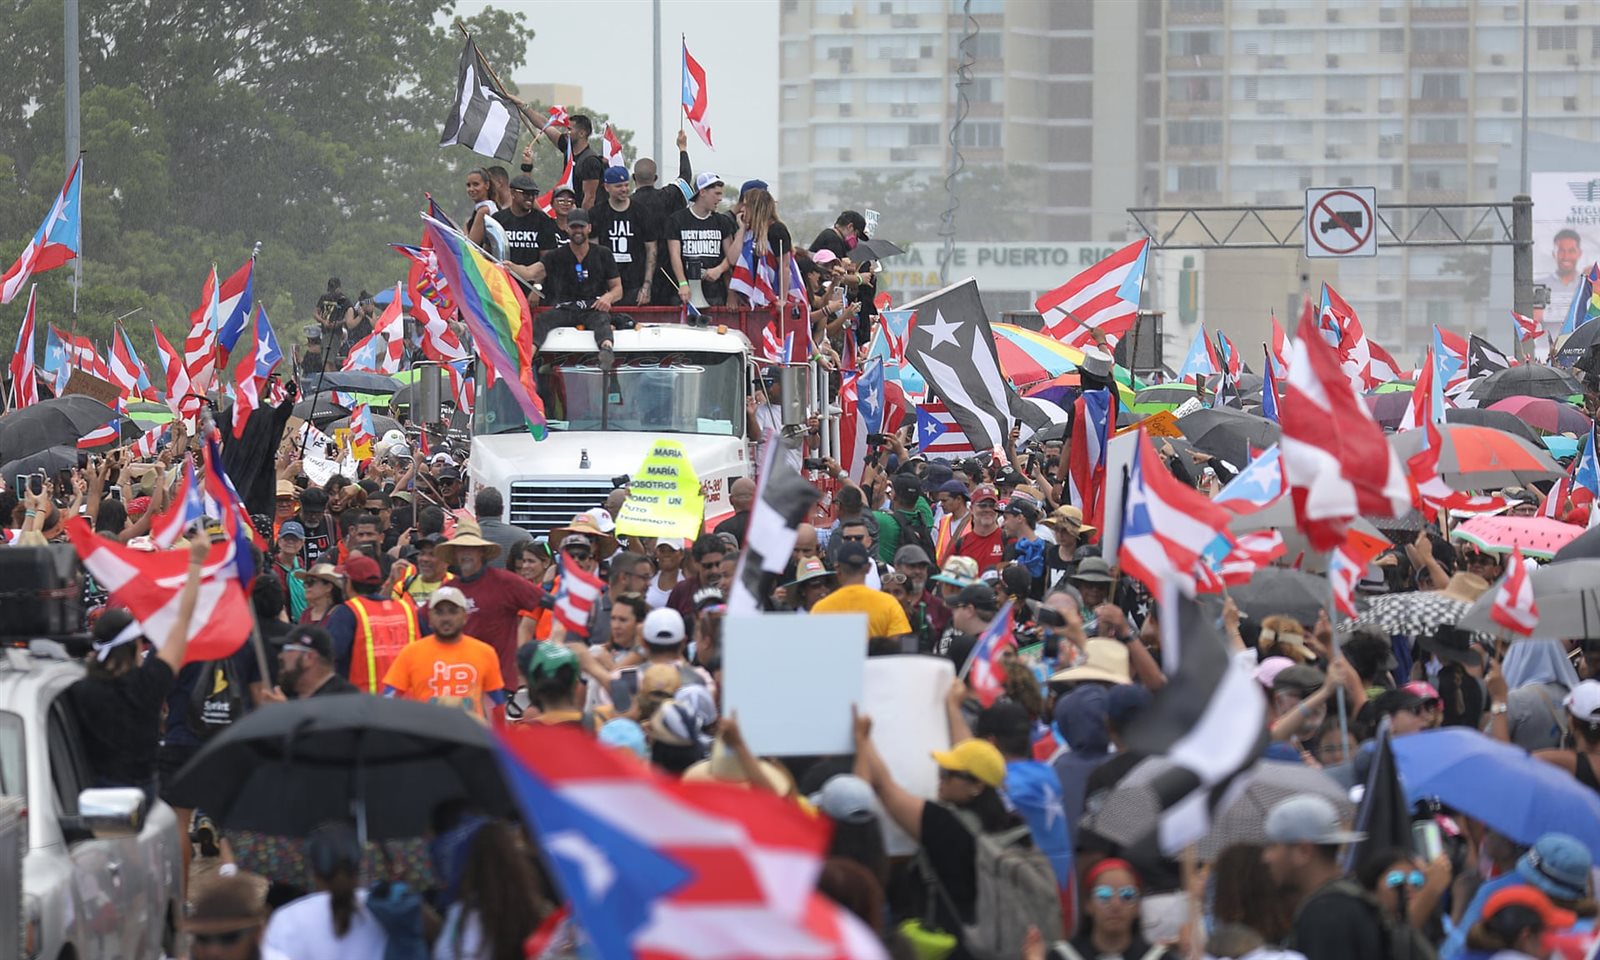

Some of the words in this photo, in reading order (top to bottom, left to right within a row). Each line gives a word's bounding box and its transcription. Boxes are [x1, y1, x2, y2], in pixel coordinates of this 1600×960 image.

[1570, 205, 1600, 215] SEGU
[1566, 215, 1600, 225] MULT
[608, 220, 634, 236] JAL
[505, 230, 539, 241] RICKY
[609, 236, 628, 253] TO
[682, 240, 721, 254] RENUNCIA
[977, 247, 1069, 267] PUERTO
[629, 494, 659, 504] OMOS
[668, 496, 682, 505] UN
